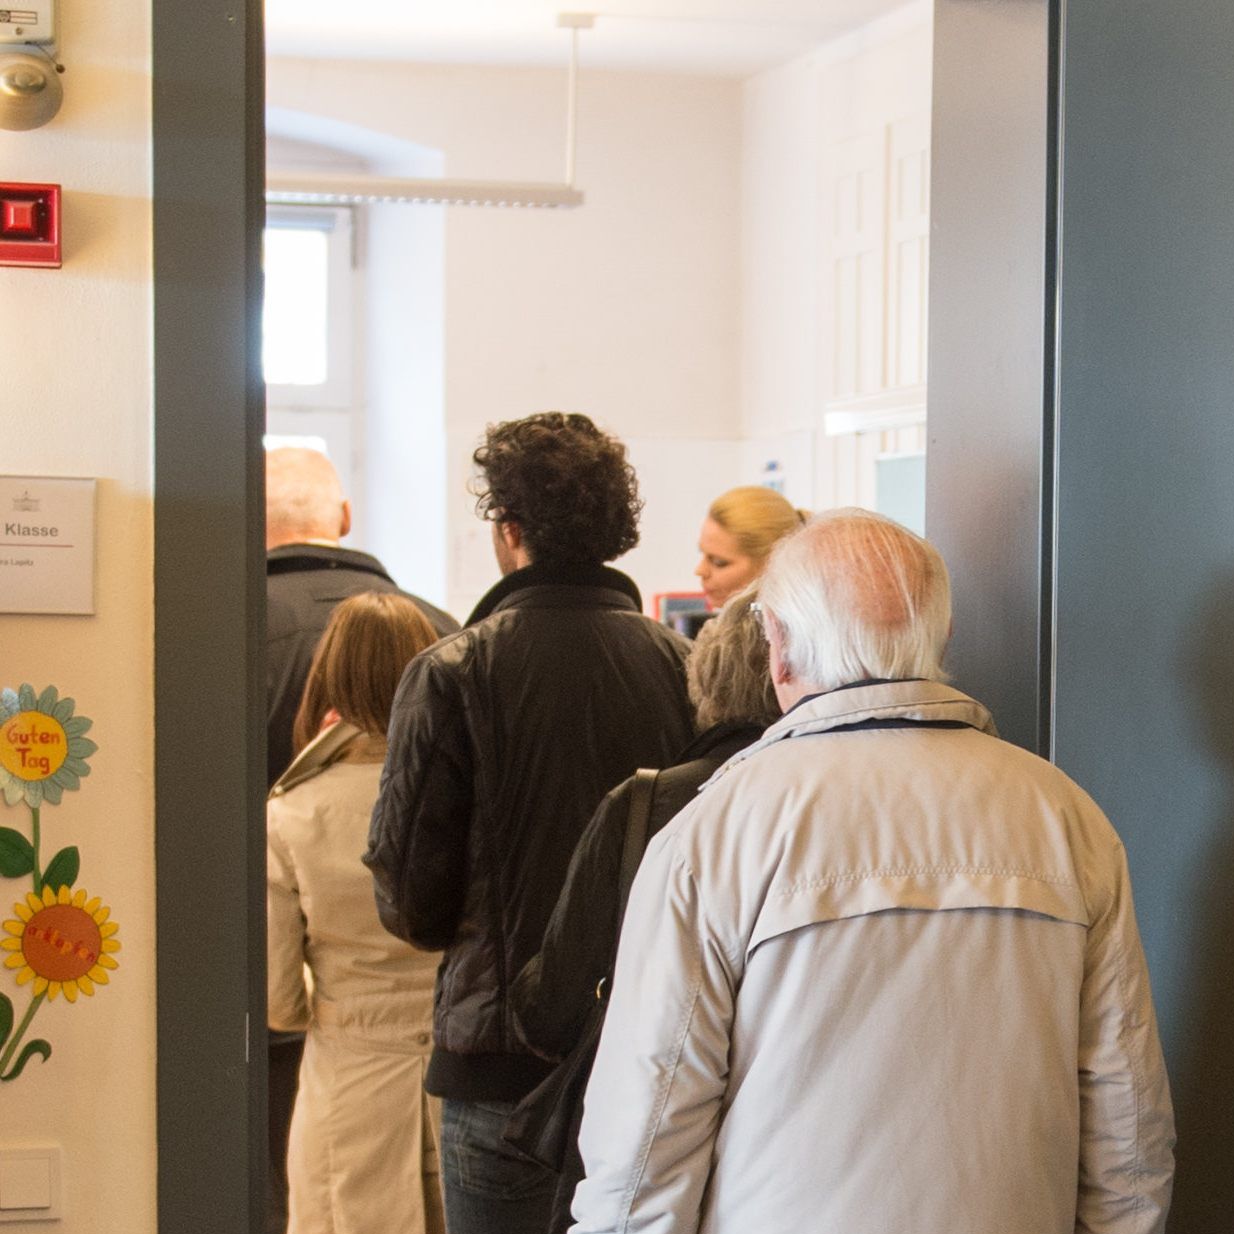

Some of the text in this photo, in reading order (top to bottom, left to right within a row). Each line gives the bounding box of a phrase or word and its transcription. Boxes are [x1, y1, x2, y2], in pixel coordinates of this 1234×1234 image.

[5, 523, 59, 537] Klasse
[6, 723, 61, 745] Guten
[15, 747, 51, 775] Tag
